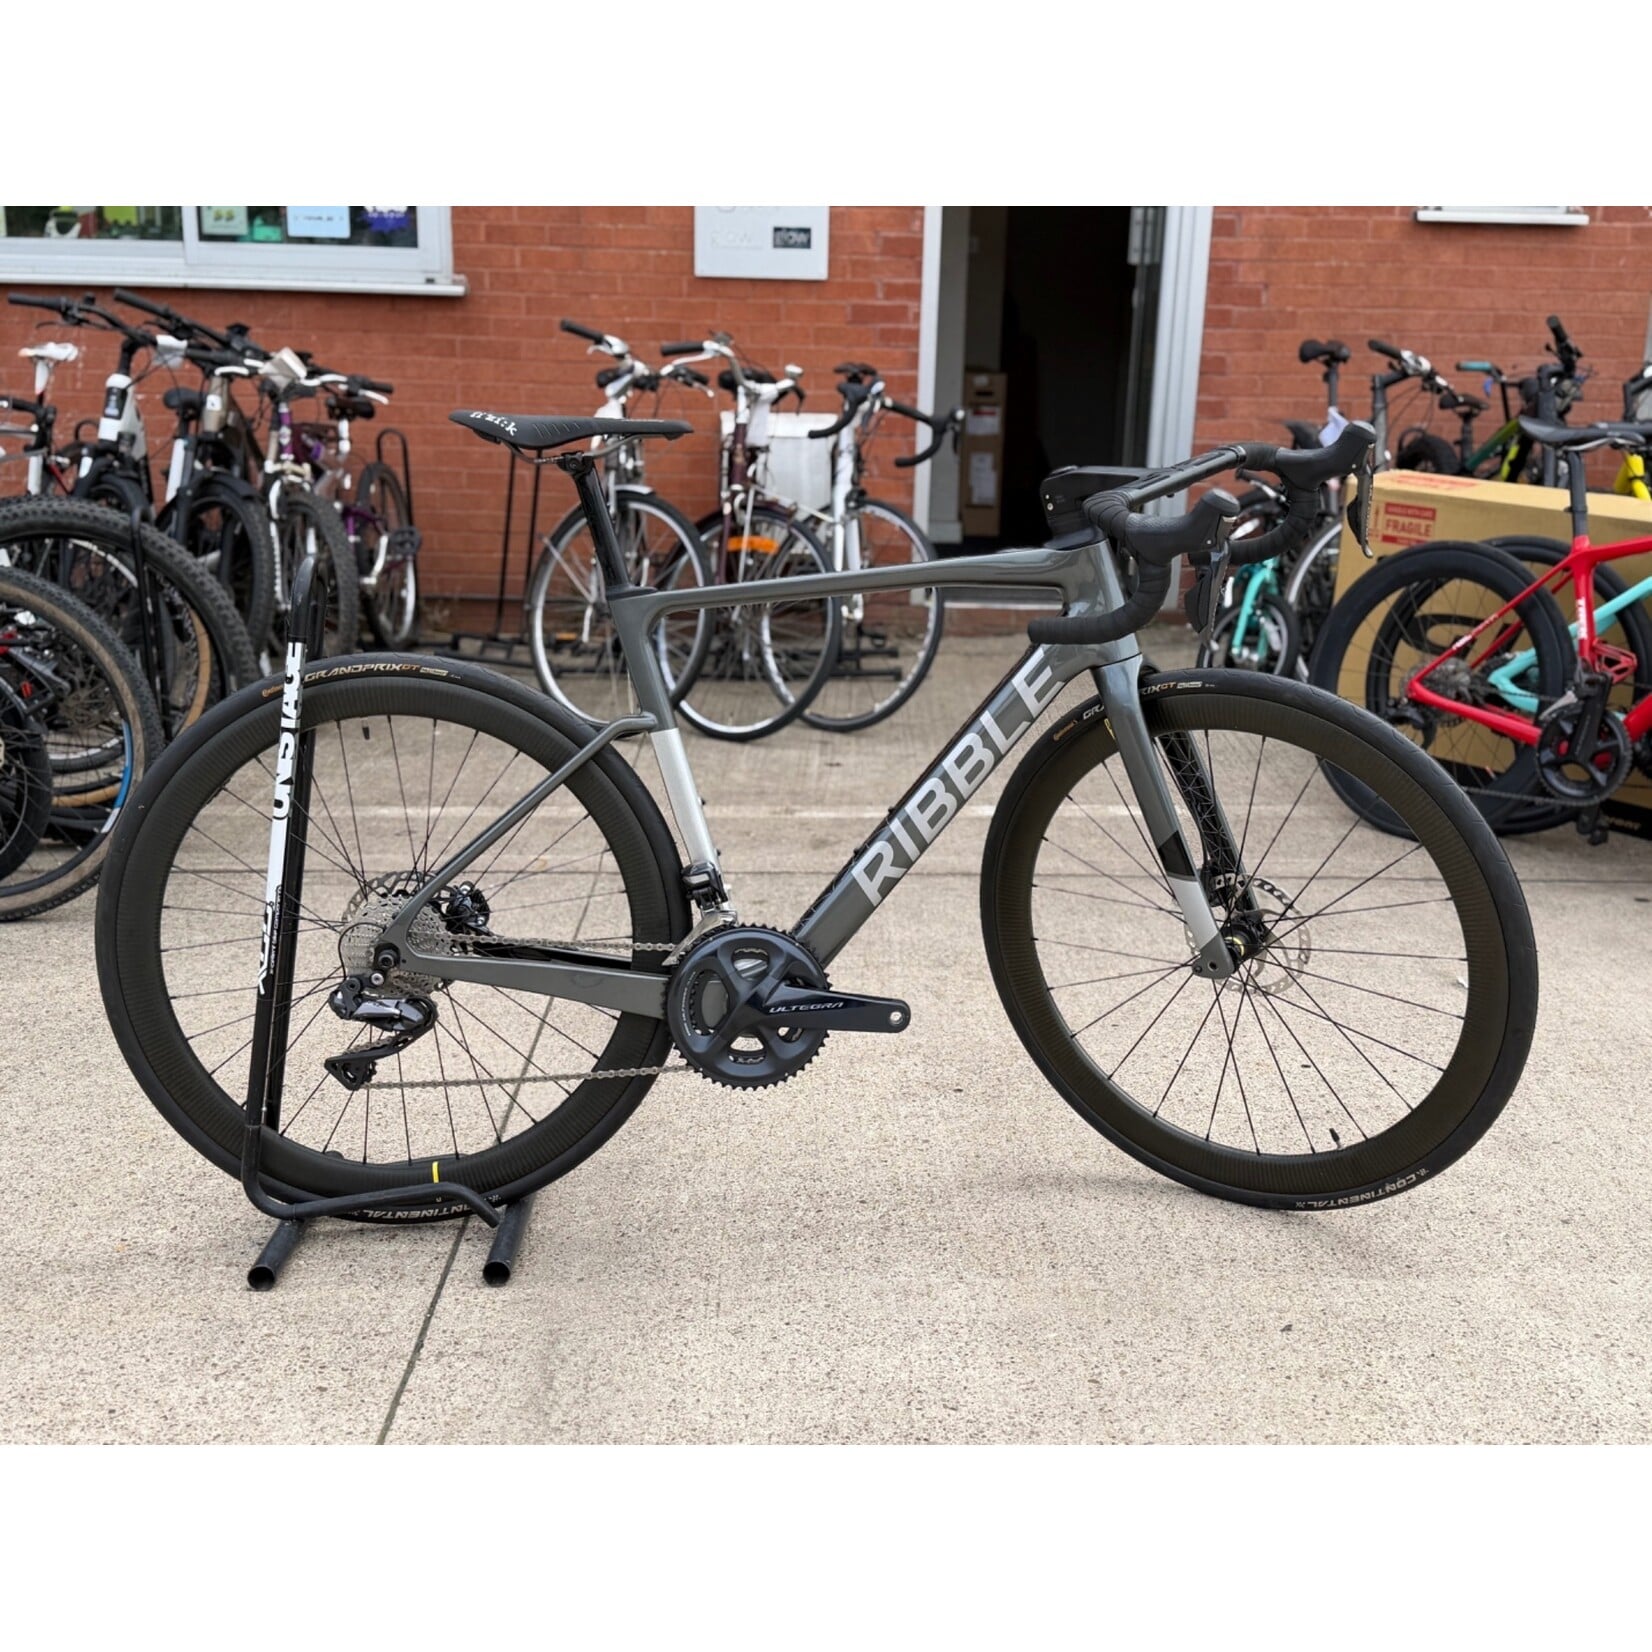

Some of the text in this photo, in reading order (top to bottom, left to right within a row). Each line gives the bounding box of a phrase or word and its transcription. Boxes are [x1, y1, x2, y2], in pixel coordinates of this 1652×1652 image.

[1386, 518, 1432, 537] FRAGILE
[851, 647, 1065, 907] RIBBLE
[768, 1001, 844, 1013] ULTEGRA
[1308, 1174, 1417, 1208] CONTINENTAL
